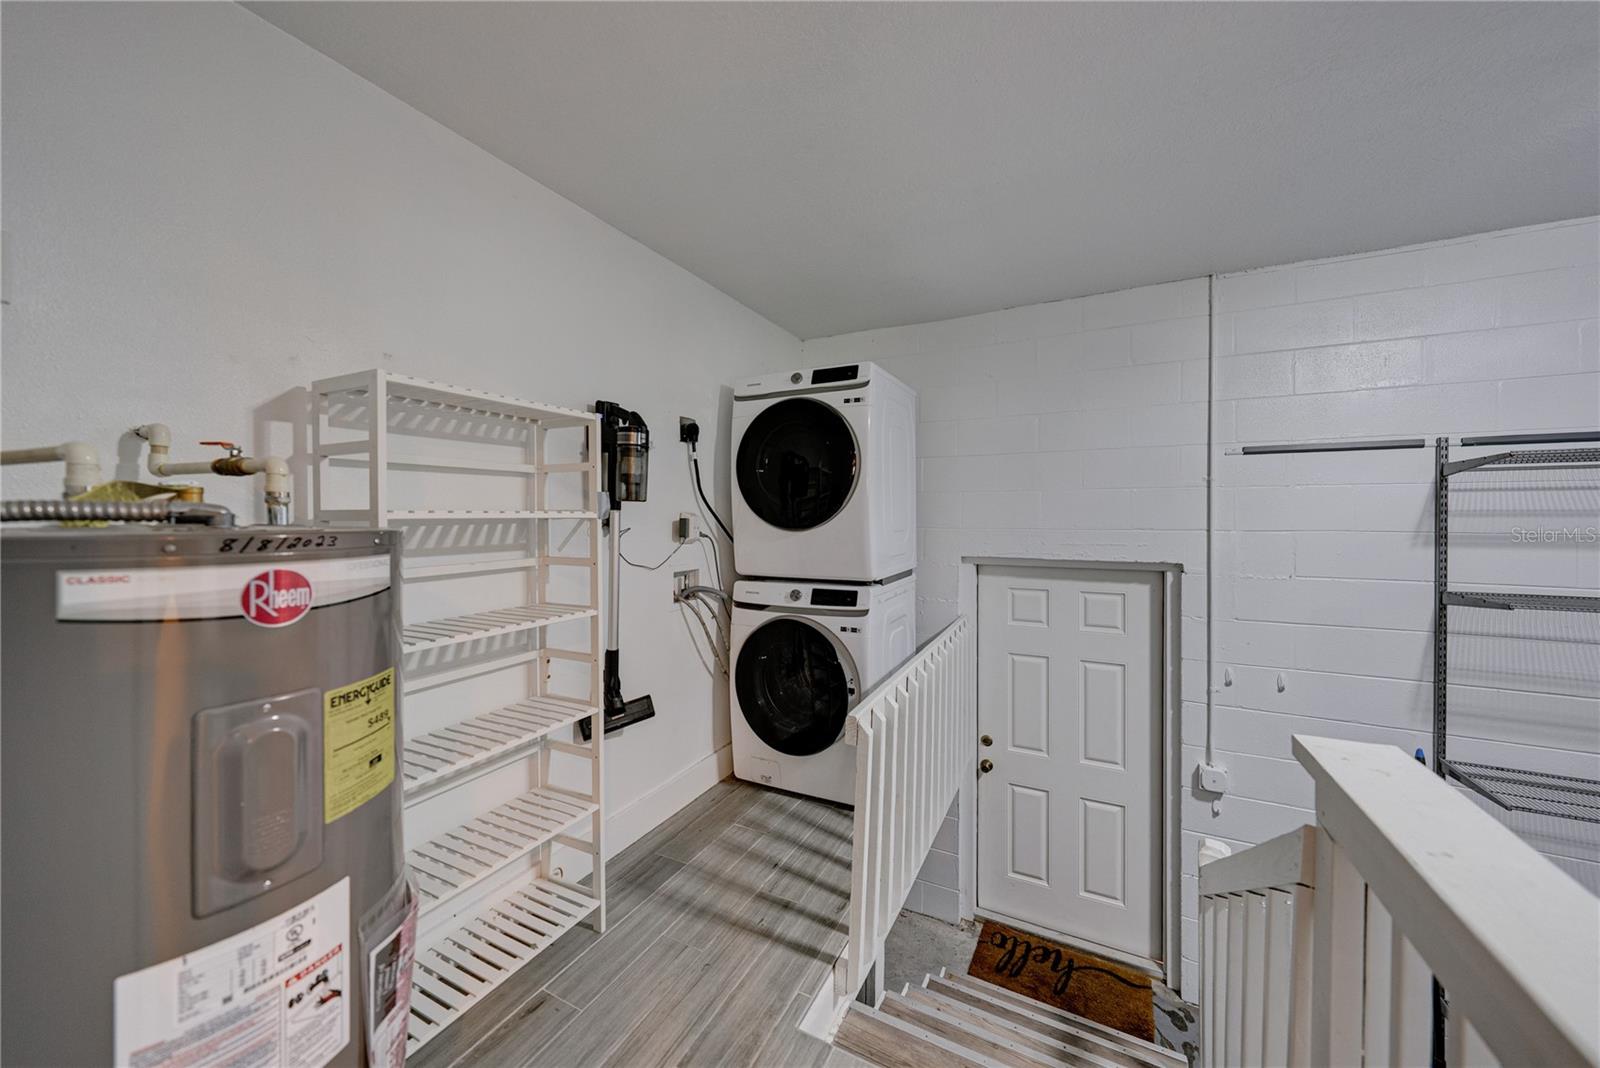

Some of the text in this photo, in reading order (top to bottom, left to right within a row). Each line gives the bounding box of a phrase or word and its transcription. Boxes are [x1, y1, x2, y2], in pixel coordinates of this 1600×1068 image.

[64, 575, 129, 585] CLASSIC
[249, 569, 310, 618] Rheem
[978, 931, 1152, 996] hello
